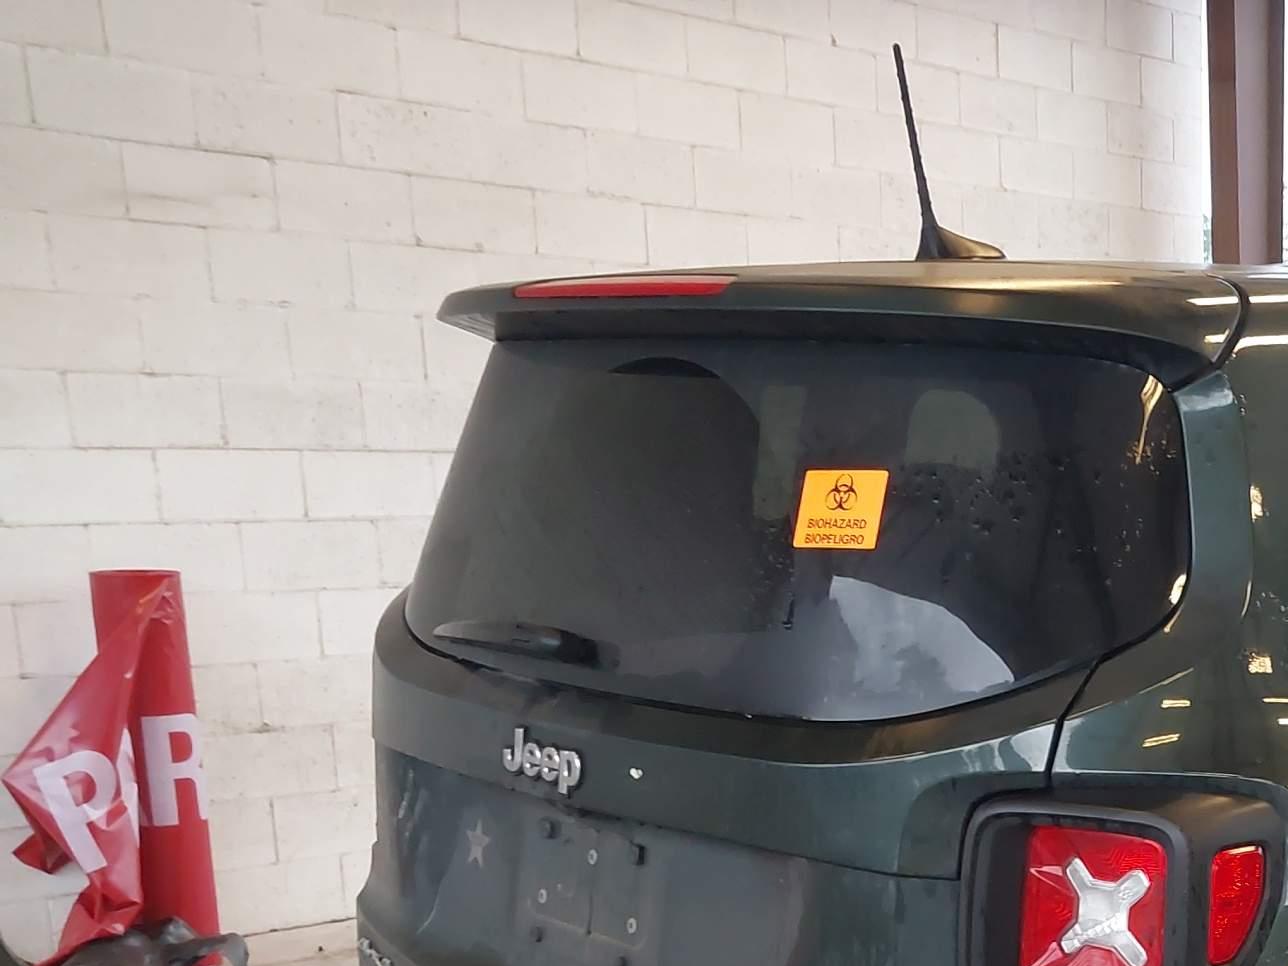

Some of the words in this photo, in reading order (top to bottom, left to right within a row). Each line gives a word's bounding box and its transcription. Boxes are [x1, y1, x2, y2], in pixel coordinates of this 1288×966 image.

[806, 518, 868, 529] BIOHAZARD
[804, 532, 865, 545] BIOPELIGRO
[503, 727, 582, 795] Jeep
